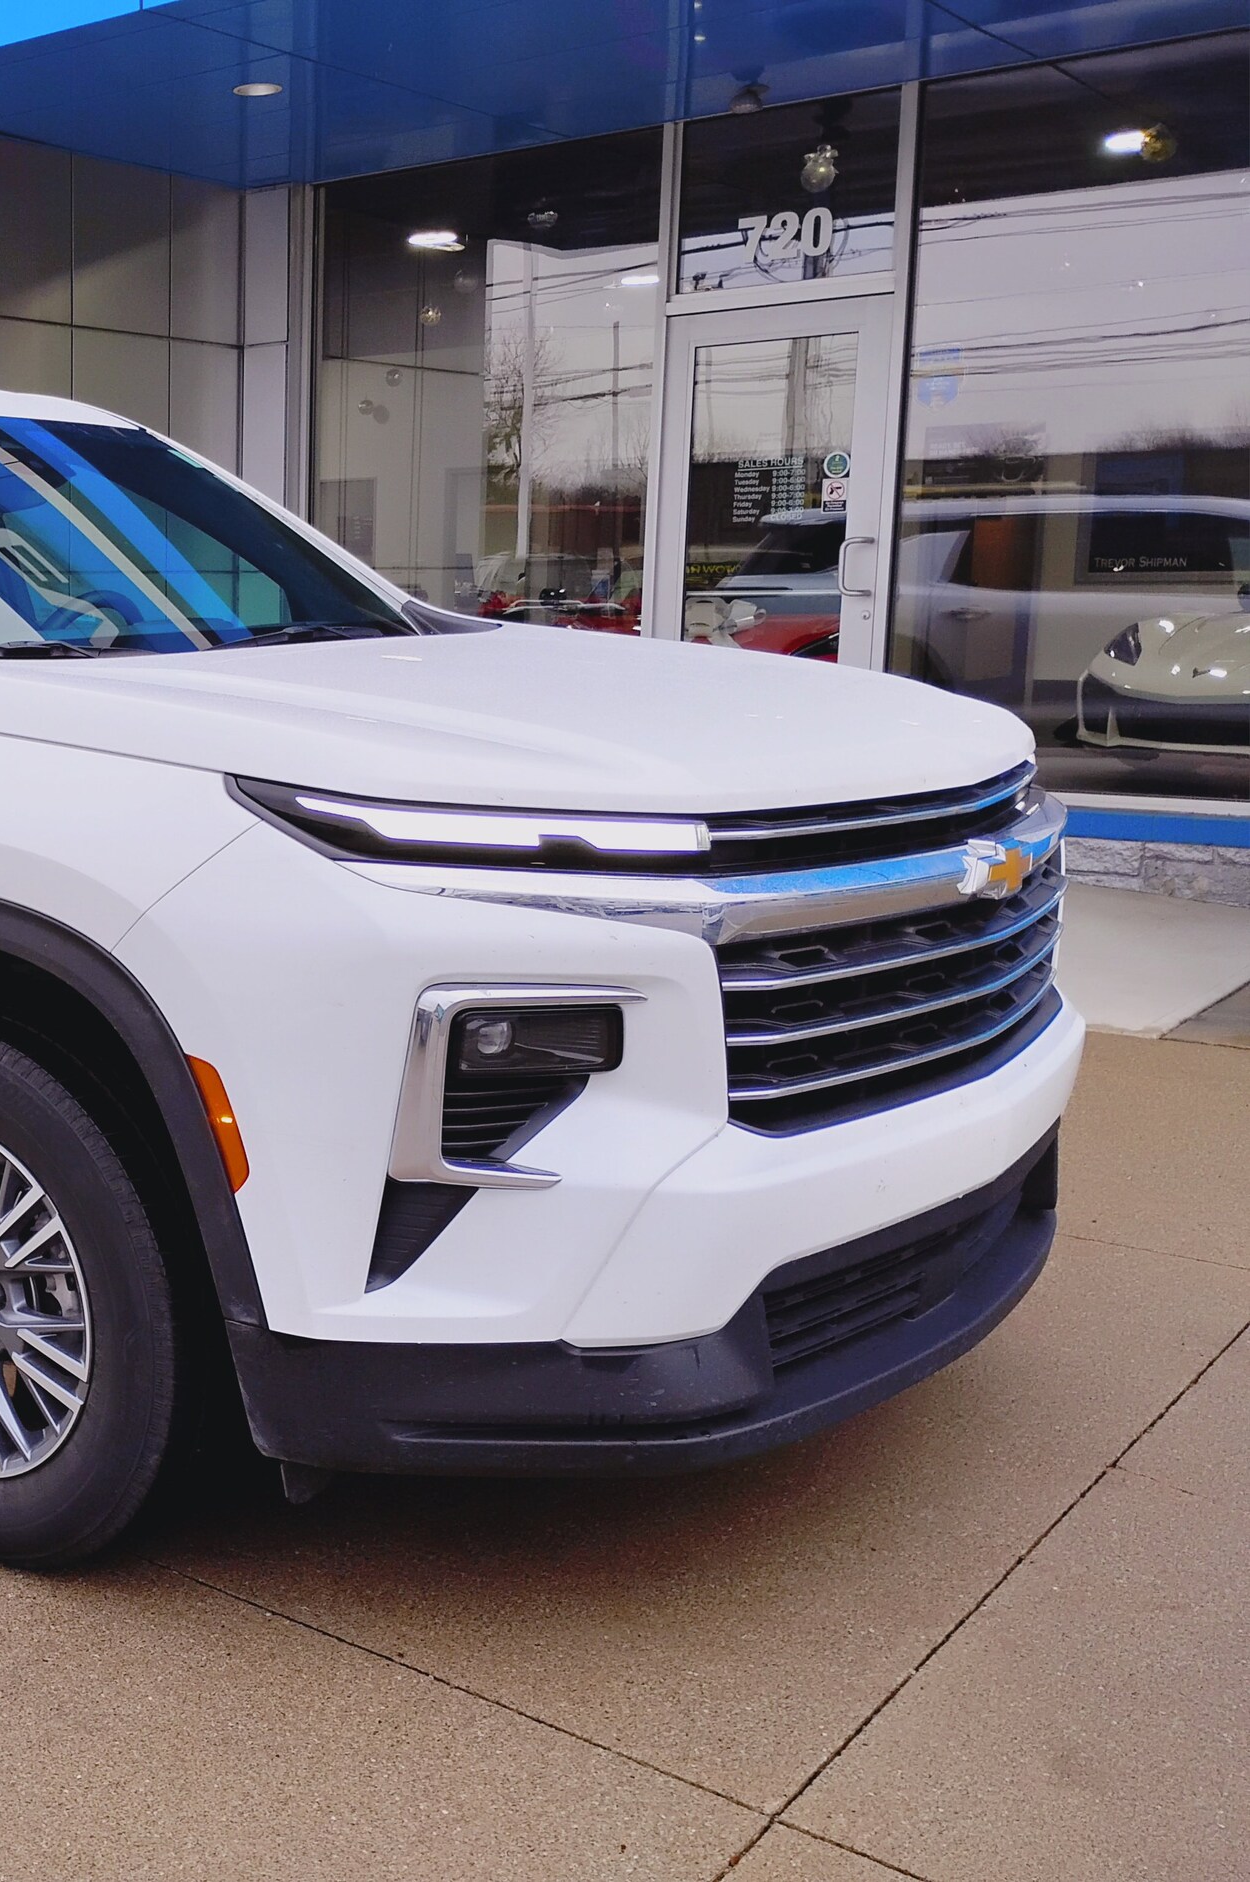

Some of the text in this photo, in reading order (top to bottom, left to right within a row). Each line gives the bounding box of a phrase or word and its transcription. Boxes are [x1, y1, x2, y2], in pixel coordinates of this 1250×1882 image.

[737, 207, 833, 262] 720
[738, 457, 804, 468] SALES HOURS
[1094, 556, 1187, 568] TREVOR SHIPMAN
